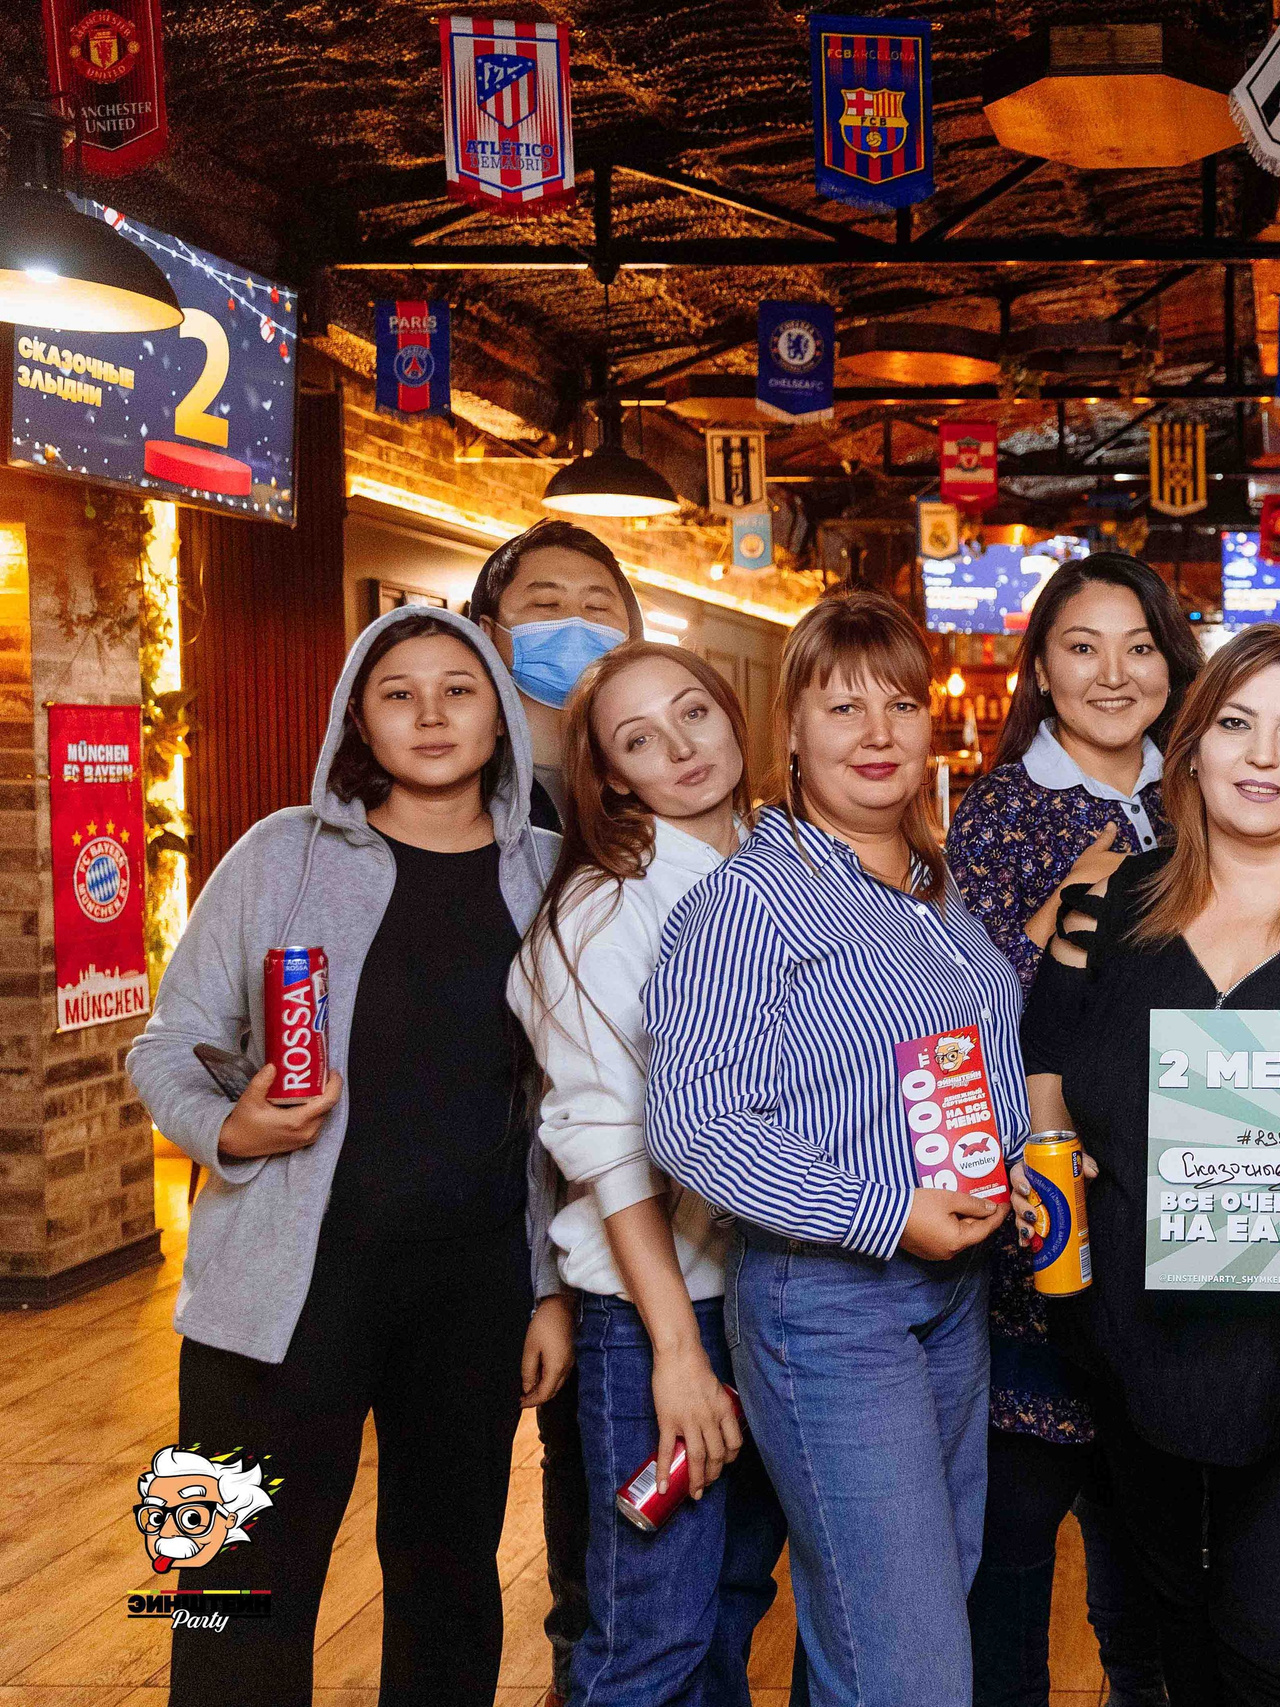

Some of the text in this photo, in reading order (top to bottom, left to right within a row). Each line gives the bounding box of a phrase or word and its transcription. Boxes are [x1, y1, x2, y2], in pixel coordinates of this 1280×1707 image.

[85, 117, 135, 134] UNITED
[860, 117, 887, 127] FCB
[465, 137, 554, 158] ATLÉTICO
[389, 315, 437, 329] PARIS
[17, 336, 136, 389] СКАЗОЧНЫЕ
[17, 365, 103, 408] ЗЛЫДНИ
[67, 740, 130, 763] MÜNCHEN
[63, 763, 134, 784] FC BAYERN
[65, 986, 144, 1025] MÜNCHEN
[282, 985, 311, 1091] ROSSA
[1158, 1049, 1190, 1089] 2
[945, 1110, 992, 1130] МЕНЮ
[946, 1101, 988, 1119] НА ВСЕ
[960, 1156, 996, 1171] Wembley
[1160, 1191, 1215, 1213] ВСЕ
[1160, 1214, 1217, 1243] НА
